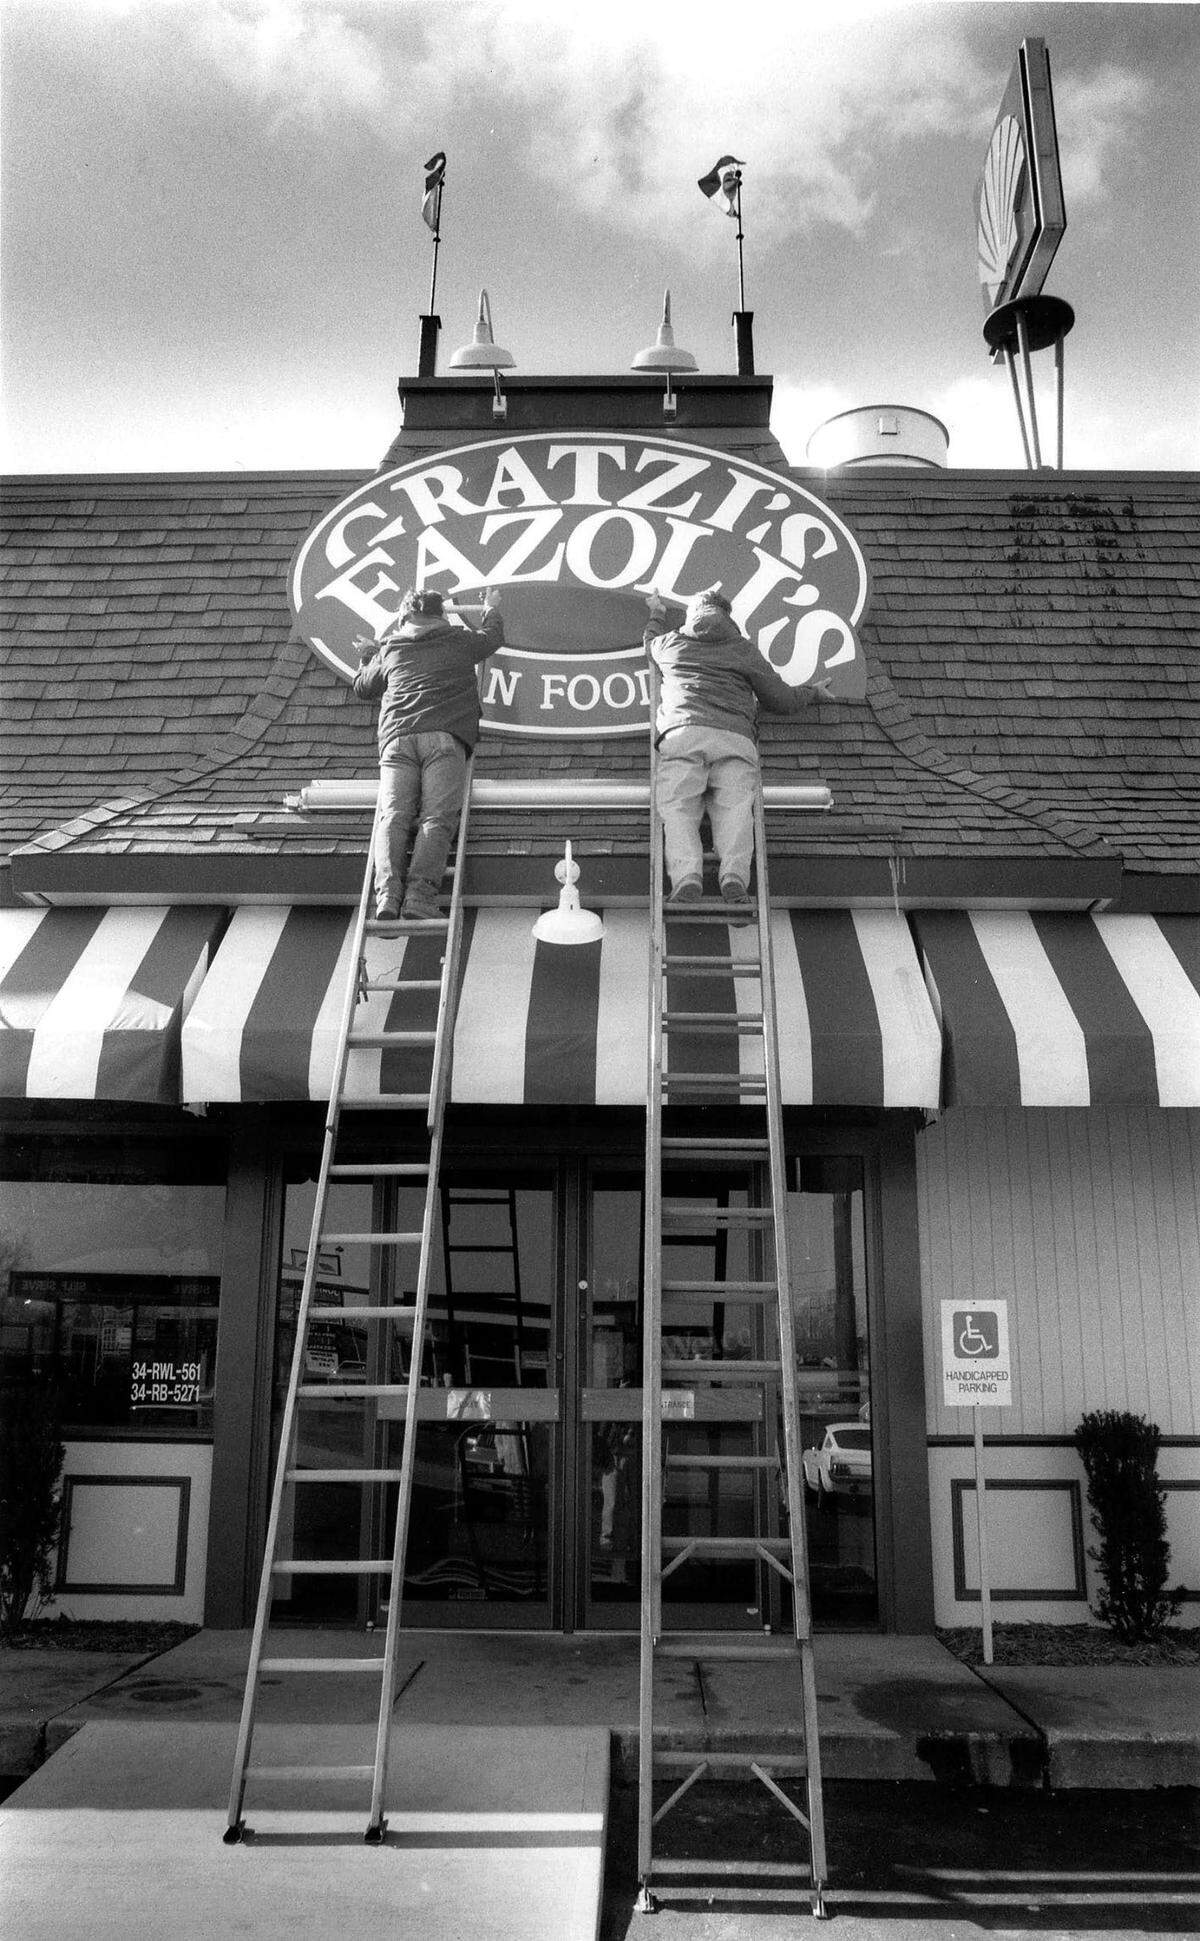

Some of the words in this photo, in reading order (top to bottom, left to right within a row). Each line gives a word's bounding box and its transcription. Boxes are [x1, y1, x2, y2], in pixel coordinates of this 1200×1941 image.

[326, 445, 838, 569] GRATZI'S
[315, 508, 856, 687] FAZOLI'S
[131, 1361, 201, 1381] 34-RWL-561
[945, 1371, 1009, 1381] HANDICAPPED
[130, 1382, 200, 1402] 34-RB-5271
[958, 1382, 998, 1393] PARKING
